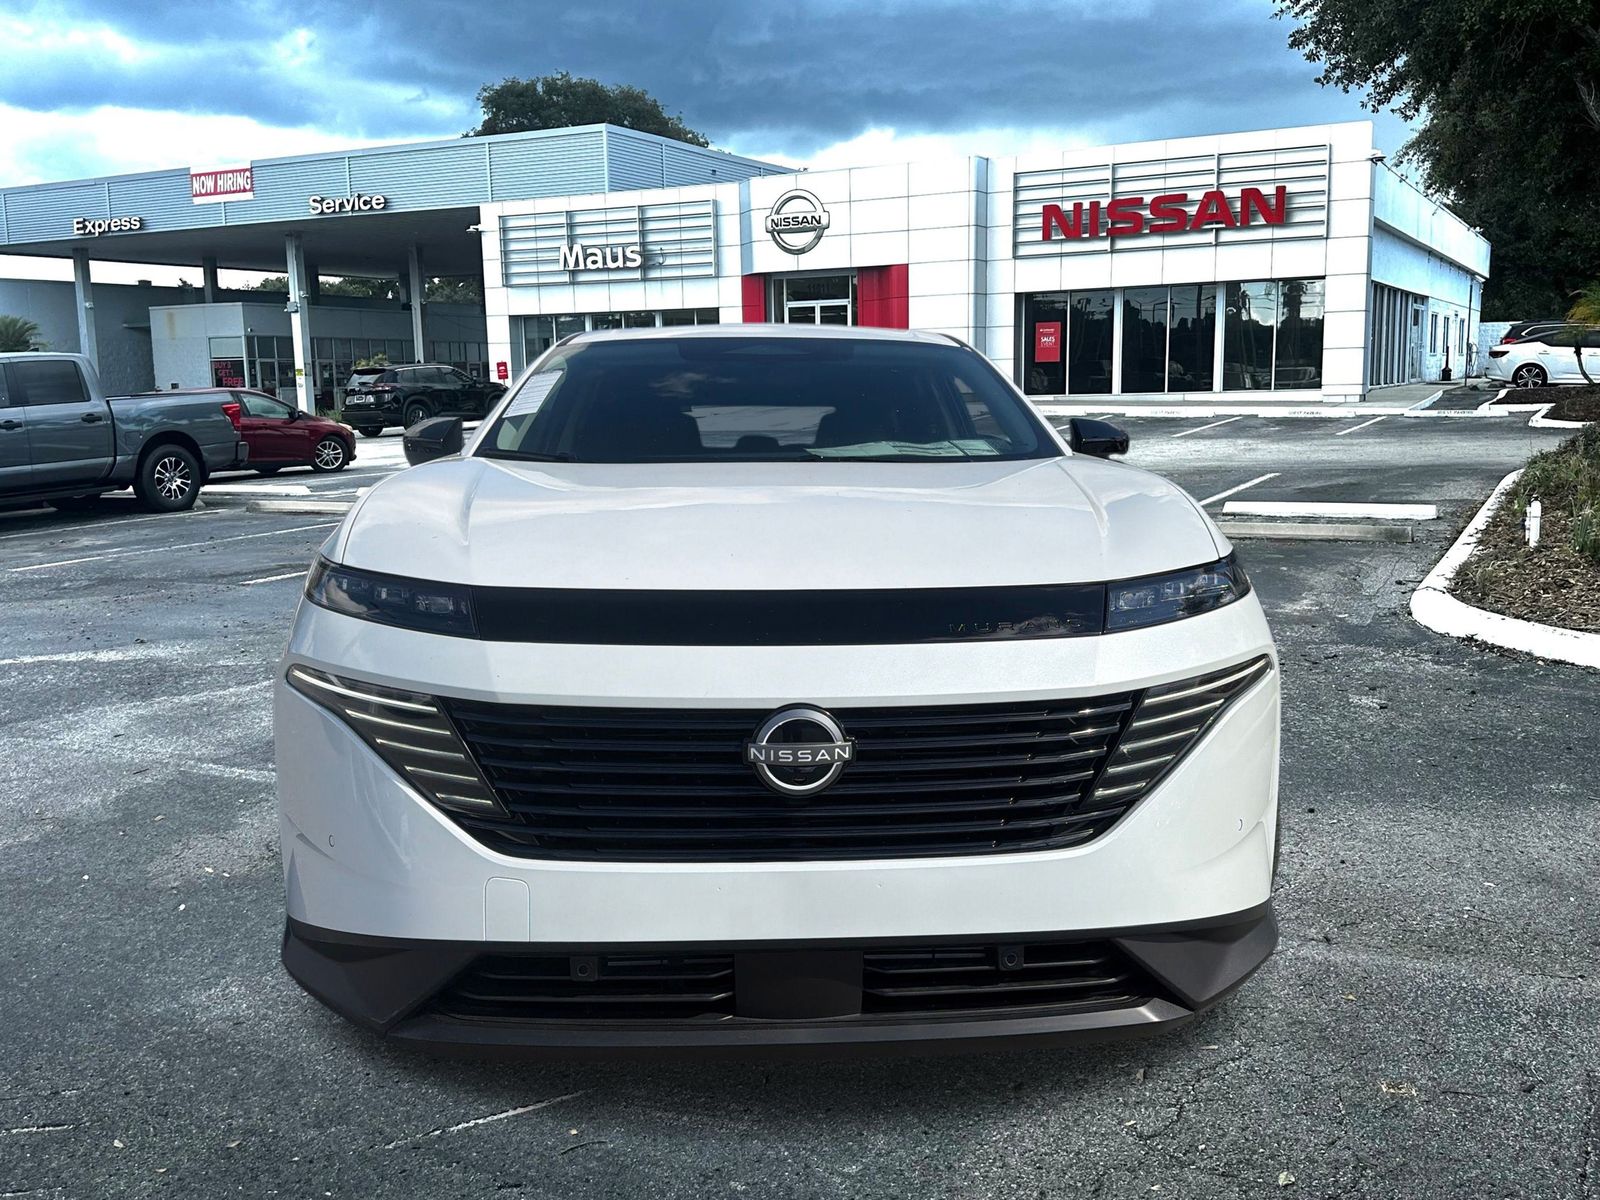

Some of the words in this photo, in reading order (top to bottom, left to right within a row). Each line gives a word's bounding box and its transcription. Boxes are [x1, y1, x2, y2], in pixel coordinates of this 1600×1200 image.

[192, 174, 215, 196] NOW
[216, 170, 251, 193] HIRING
[308, 193, 386, 215] Service
[1042, 185, 1287, 241] NISSAN
[73, 216, 141, 237] Express
[770, 214, 822, 228] NISSAN
[559, 243, 642, 271] Maus
[222, 377, 244, 387] FREE
[750, 746, 850, 762] NISSAN
